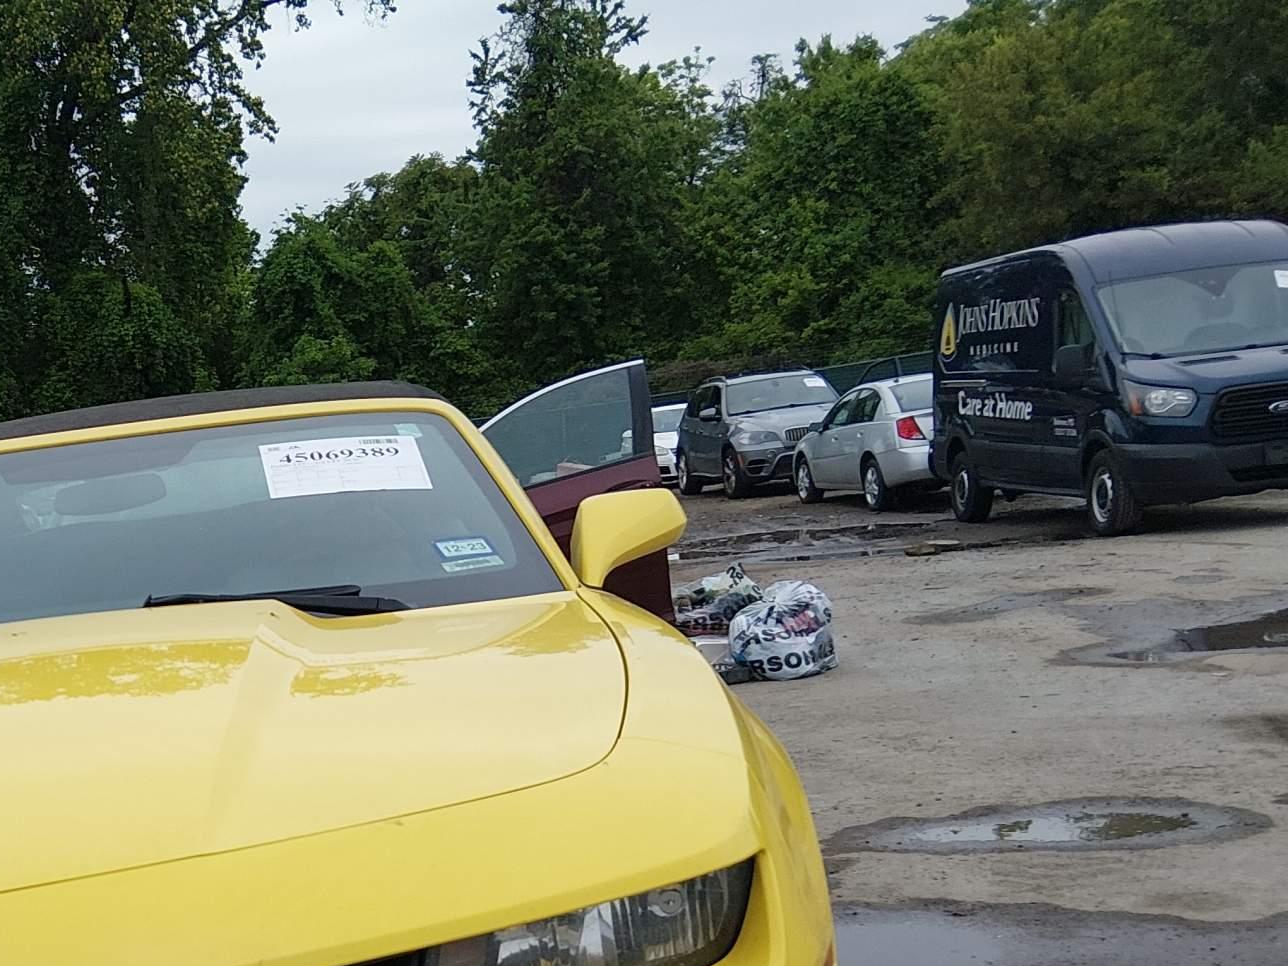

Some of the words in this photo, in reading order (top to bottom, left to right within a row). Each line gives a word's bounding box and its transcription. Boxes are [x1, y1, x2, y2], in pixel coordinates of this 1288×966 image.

[956, 304, 988, 342] JOHNS
[987, 297, 1040, 331] HOPKINS
[958, 390, 983, 416] Care
[982, 395, 995, 417] at
[995, 392, 1033, 421] Home
[279, 446, 400, 464] 45069389
